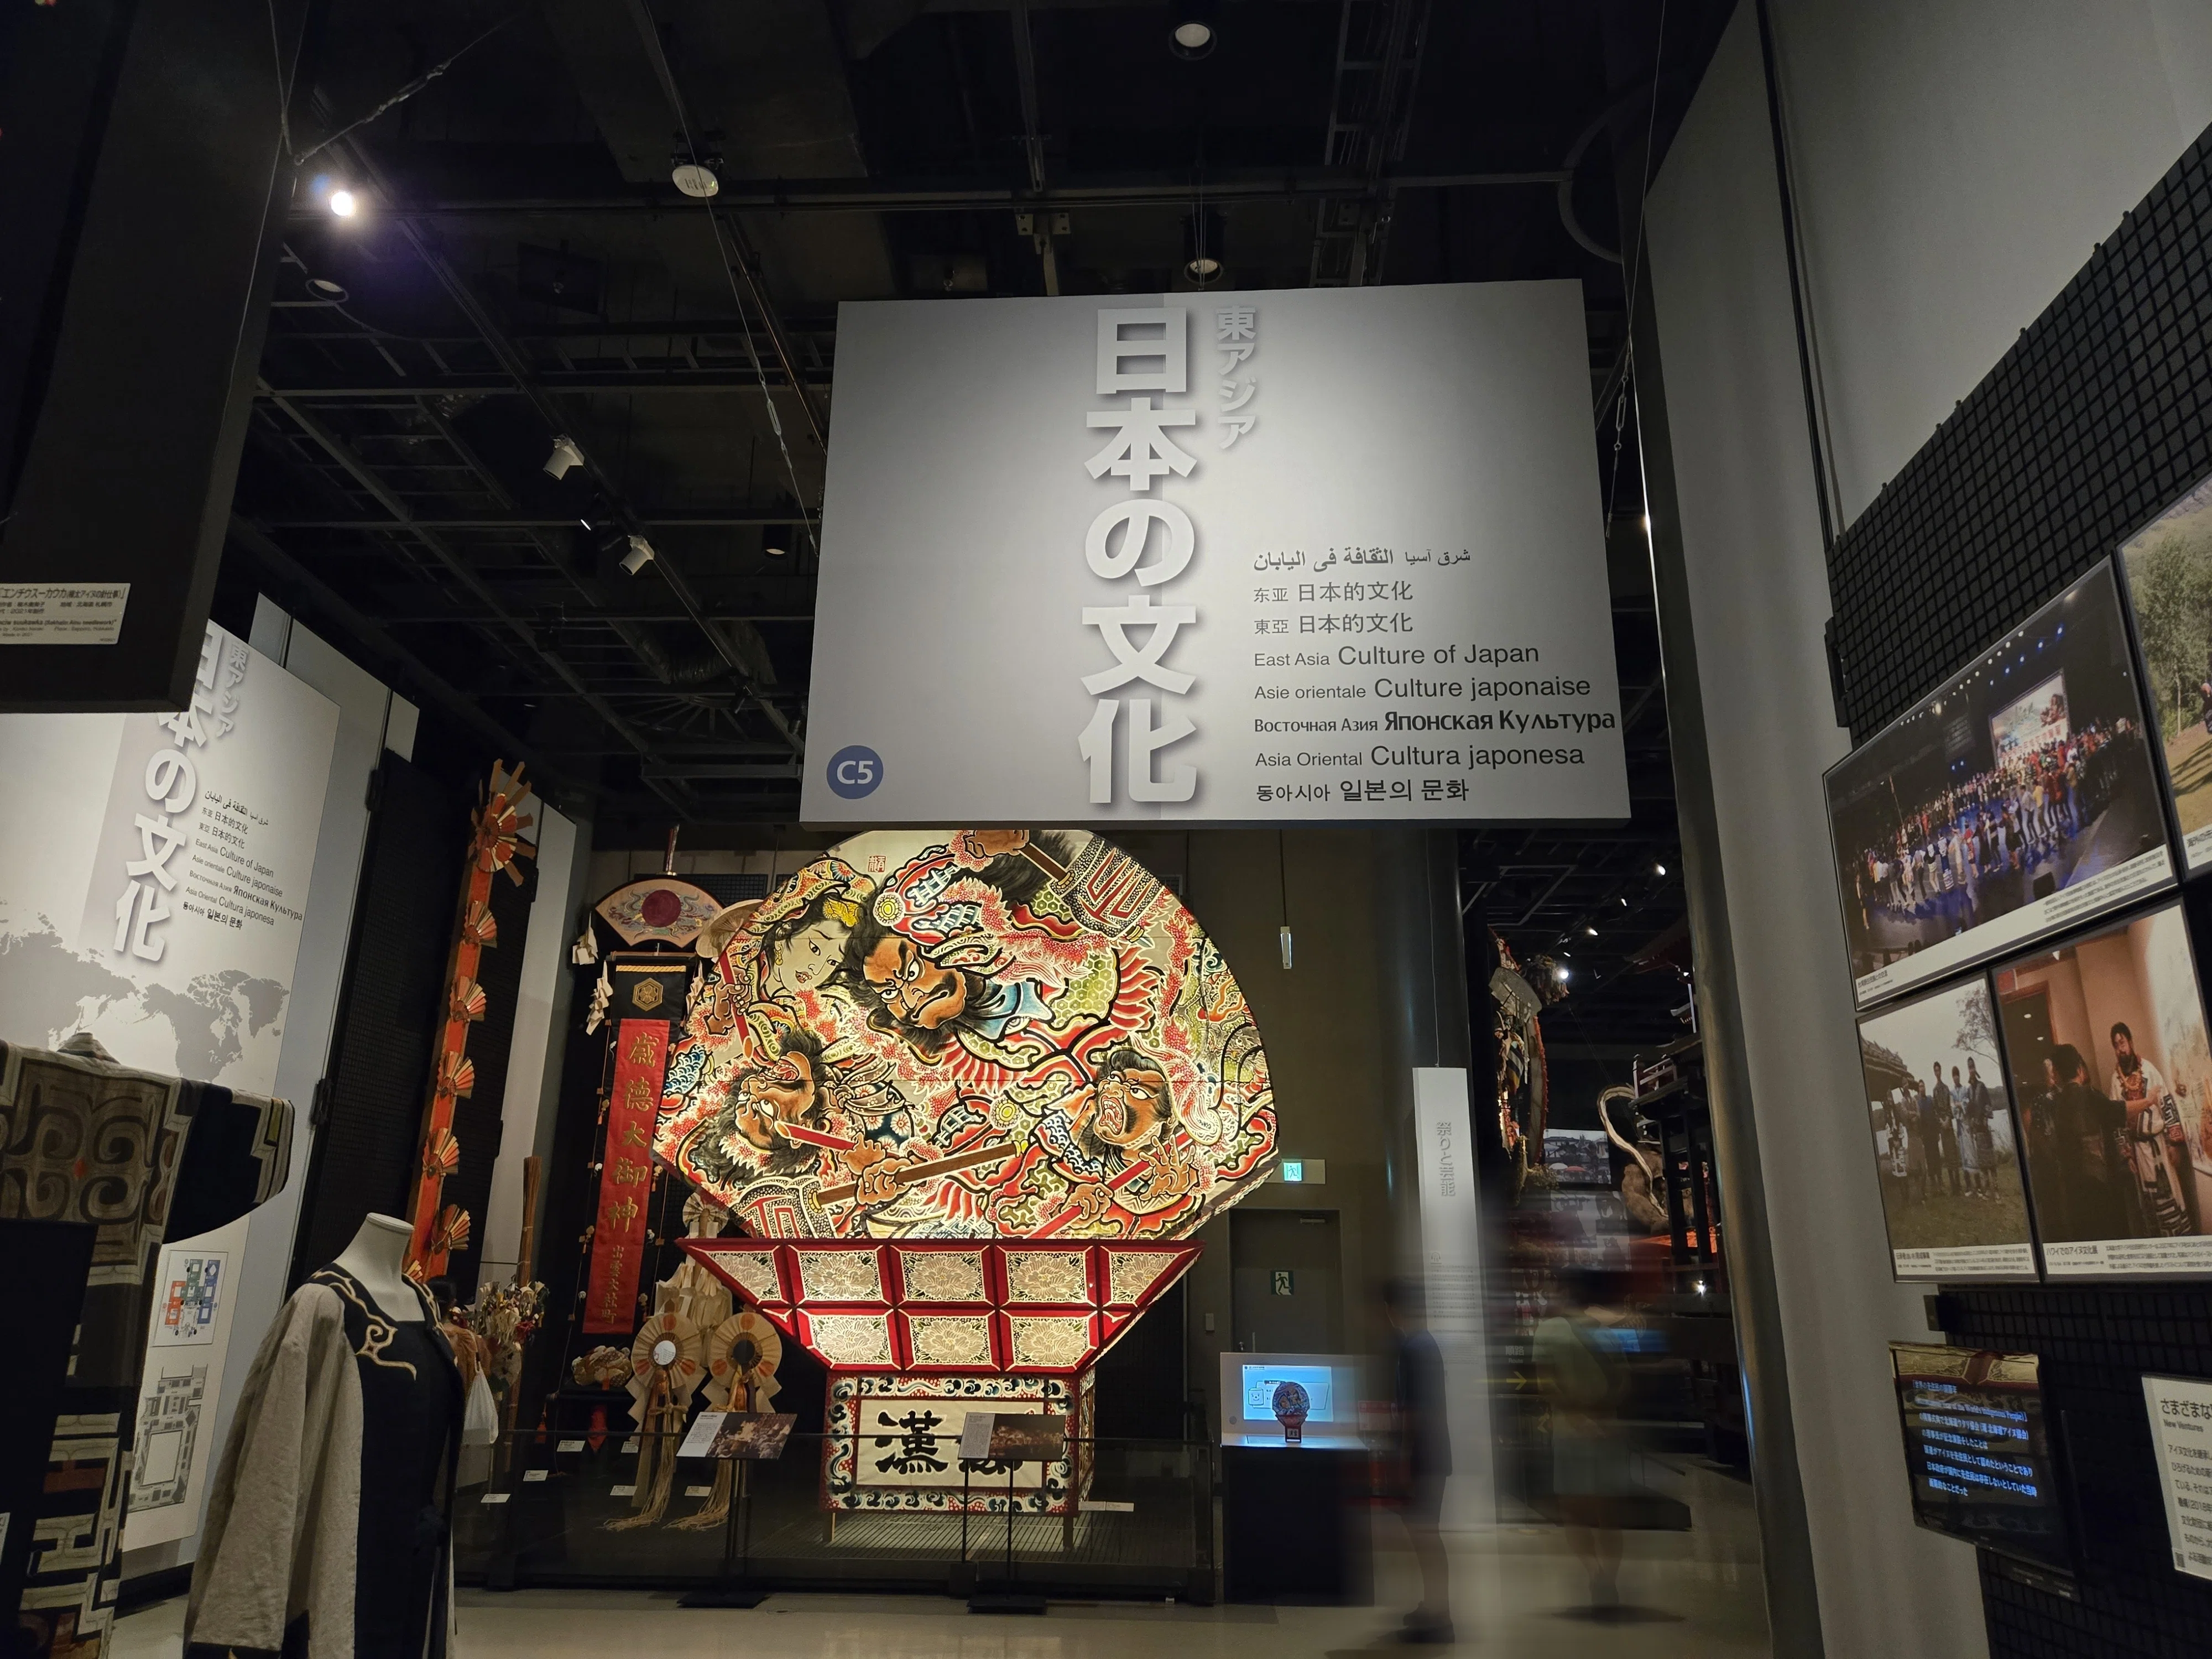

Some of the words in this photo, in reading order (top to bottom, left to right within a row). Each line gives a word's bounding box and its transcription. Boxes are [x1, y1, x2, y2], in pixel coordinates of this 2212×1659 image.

[1217, 305, 1257, 450] 東アジア
[1078, 306, 1197, 804] 日本の文化
[1253, 549, 1306, 571] اليابان
[1343, 546, 1394, 565] الثقافة
[1437, 549, 1471, 566] شرق
[1254, 588, 1289, 603] 东亚
[1298, 581, 1413, 603] 日本的文化
[1254, 619, 1290, 635] 東亞
[1299, 612, 1413, 634] 日本的文化
[1254, 653, 1290, 666] East
[1295, 653, 1331, 666] Asia
[1338, 645, 1426, 666] Culture
[1433, 645, 1456, 665] of
[1464, 644, 1540, 668] Japan
[215, 642, 249, 738] 東アジア
[1254, 686, 1290, 700] Asie
[1295, 685, 1366, 699] orientale
[1374, 678, 1463, 698] Culture
[1470, 677, 1591, 702] japonaise
[1254, 719, 1337, 733] Восточная
[1341, 718, 1378, 732] Азия
[1385, 712, 1493, 731] Японская
[1499, 710, 1615, 734] Культура
[1255, 753, 1292, 766] Asia
[1296, 752, 1363, 766] Oriental
[1371, 745, 1460, 766] Cultura
[1468, 744, 1585, 769] japonesa
[837, 760, 874, 785] C5
[1256, 785, 1331, 802] 동아시아
[1339, 779, 1413, 802] 일본의
[1421, 779, 1469, 802] 문화
[215, 811, 249, 834] 日本的文化
[212, 826, 245, 849] 日本的文化
[195, 838, 207, 850] East
[207, 844, 218, 854] Asia
[220, 847, 244, 865] Culture
[246, 859, 253, 869] of
[254, 862, 274, 878] Japan
[192, 854, 204, 864] Asie
[205, 860, 225, 874] orientale
[227, 866, 251, 884] Culture
[251, 878, 283, 897] japonaise
[186, 886, 197, 896] Asia
[198, 891, 218, 904] Oriental
[218, 896, 243, 914] Cultura
[244, 907, 274, 926] japonesa
[190, 870, 218, 888] Восточная
[219, 883, 232, 893] Азия
[233, 885, 269, 907] Японская
[270, 900, 303, 921] Культура
[183, 901, 205, 916] 동아시아
[207, 909, 228, 925] 일본의
[229, 916, 243, 930] 문화
[2161, 1398, 2212, 1420] さまざまな
[2163, 1418, 2176, 1428] New
[2177, 1421, 2204, 1432] Ventures
